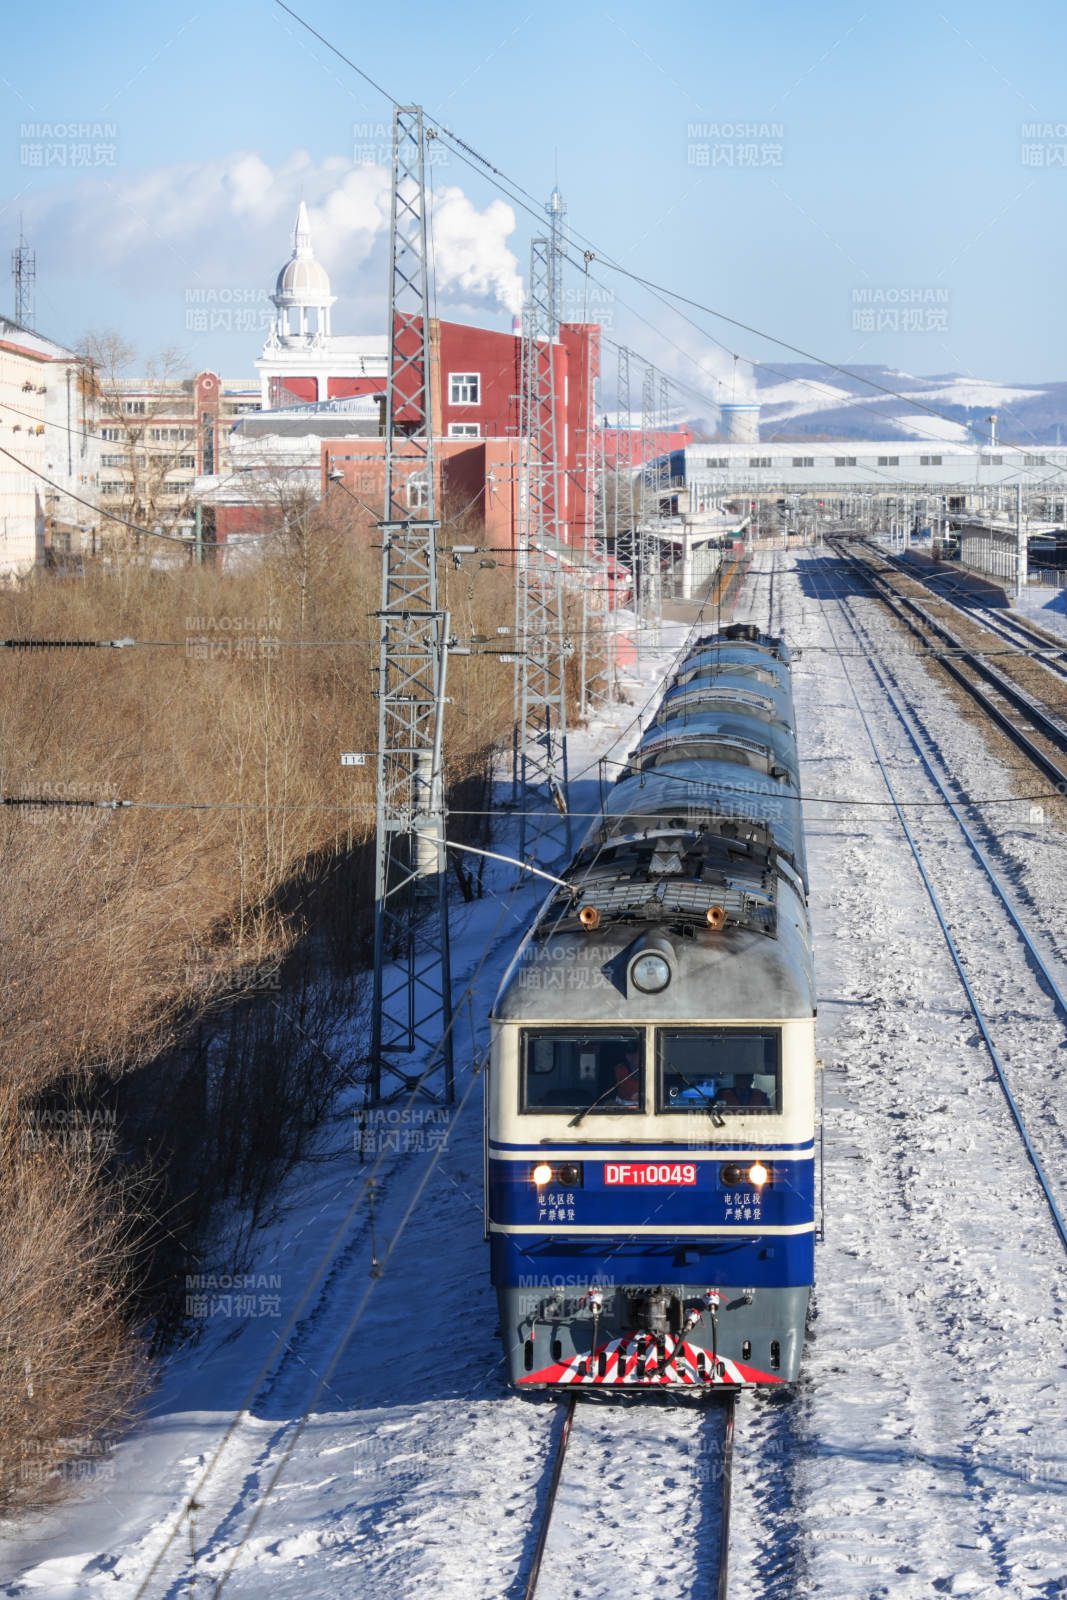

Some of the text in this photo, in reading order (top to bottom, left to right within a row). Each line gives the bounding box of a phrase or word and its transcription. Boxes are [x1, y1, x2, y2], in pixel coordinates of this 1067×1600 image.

[538, 1193, 575, 1206] 电化区段
[724, 1193, 761, 1206] 电化区段
[539, 1208, 576, 1221] 严禁攀登
[725, 1207, 761, 1221] 严禁攀登
